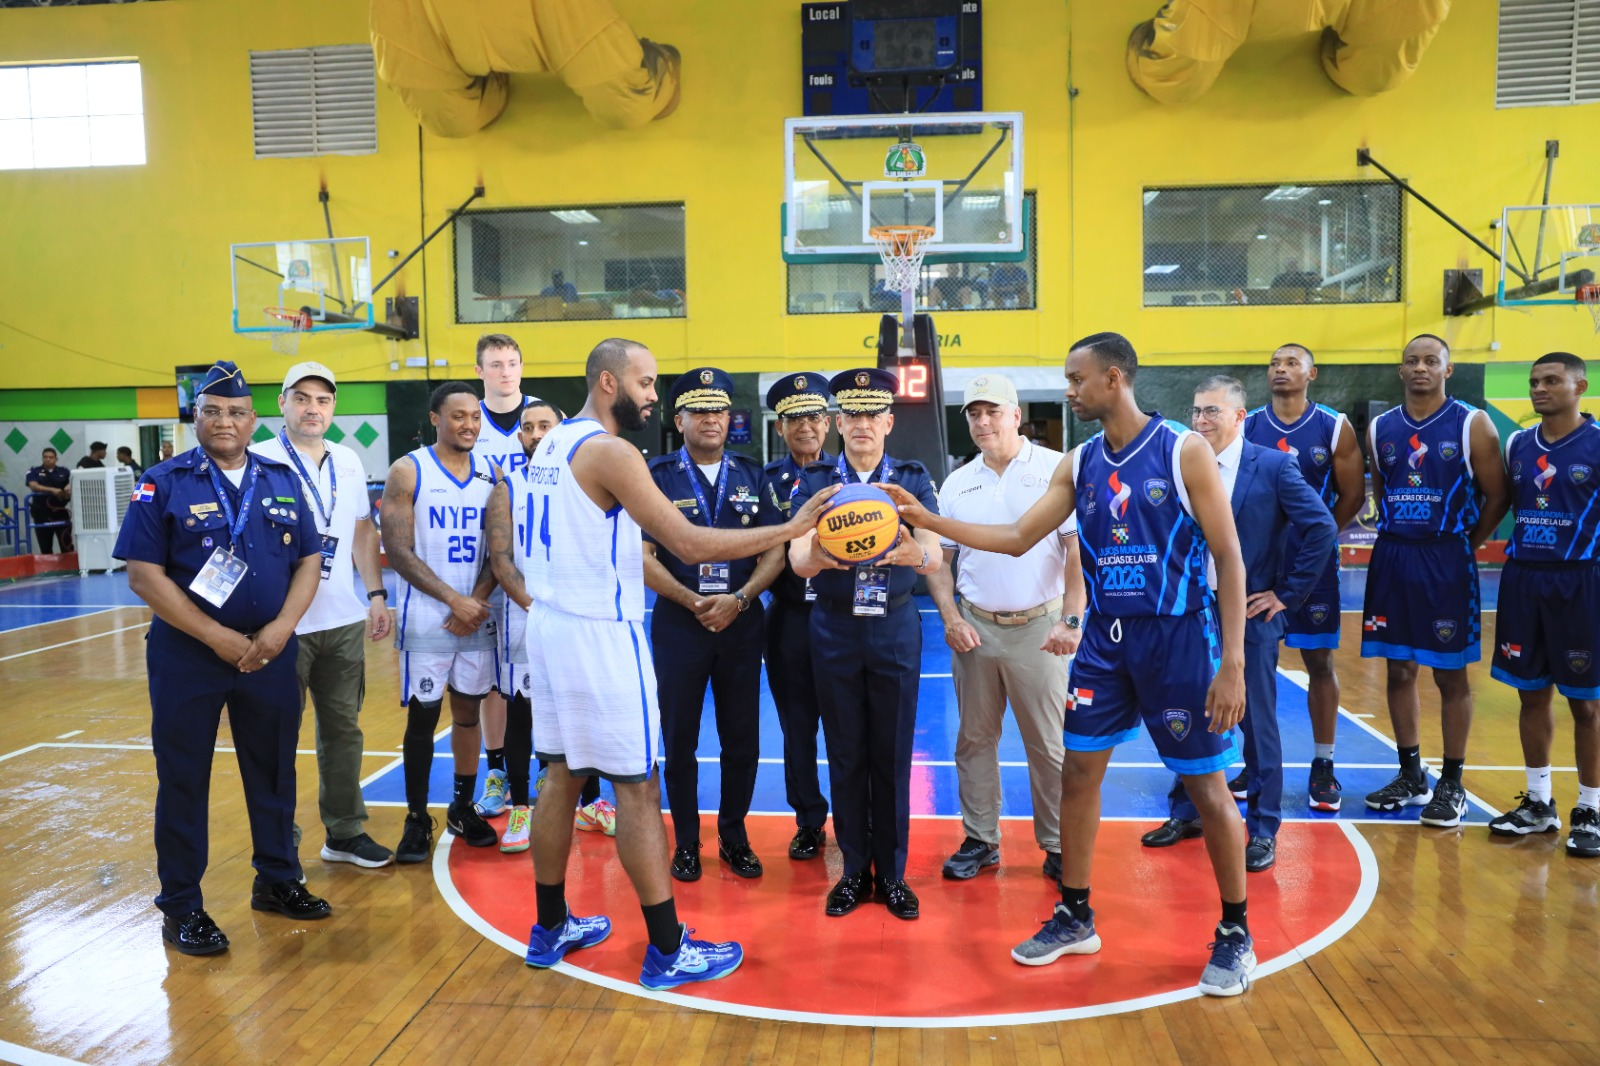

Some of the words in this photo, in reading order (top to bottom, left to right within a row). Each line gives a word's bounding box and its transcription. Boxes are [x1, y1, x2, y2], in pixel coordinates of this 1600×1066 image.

[809, 7, 840, 20] Local
[898, 365, 928, 398] 12
[826, 509, 884, 532] Wilson
[1394, 502, 1431, 520] 2026
[526, 492, 552, 562] 14
[1522, 524, 1558, 545] 2026
[448, 535, 477, 563] 25
[1102, 565, 1146, 590] 2026
